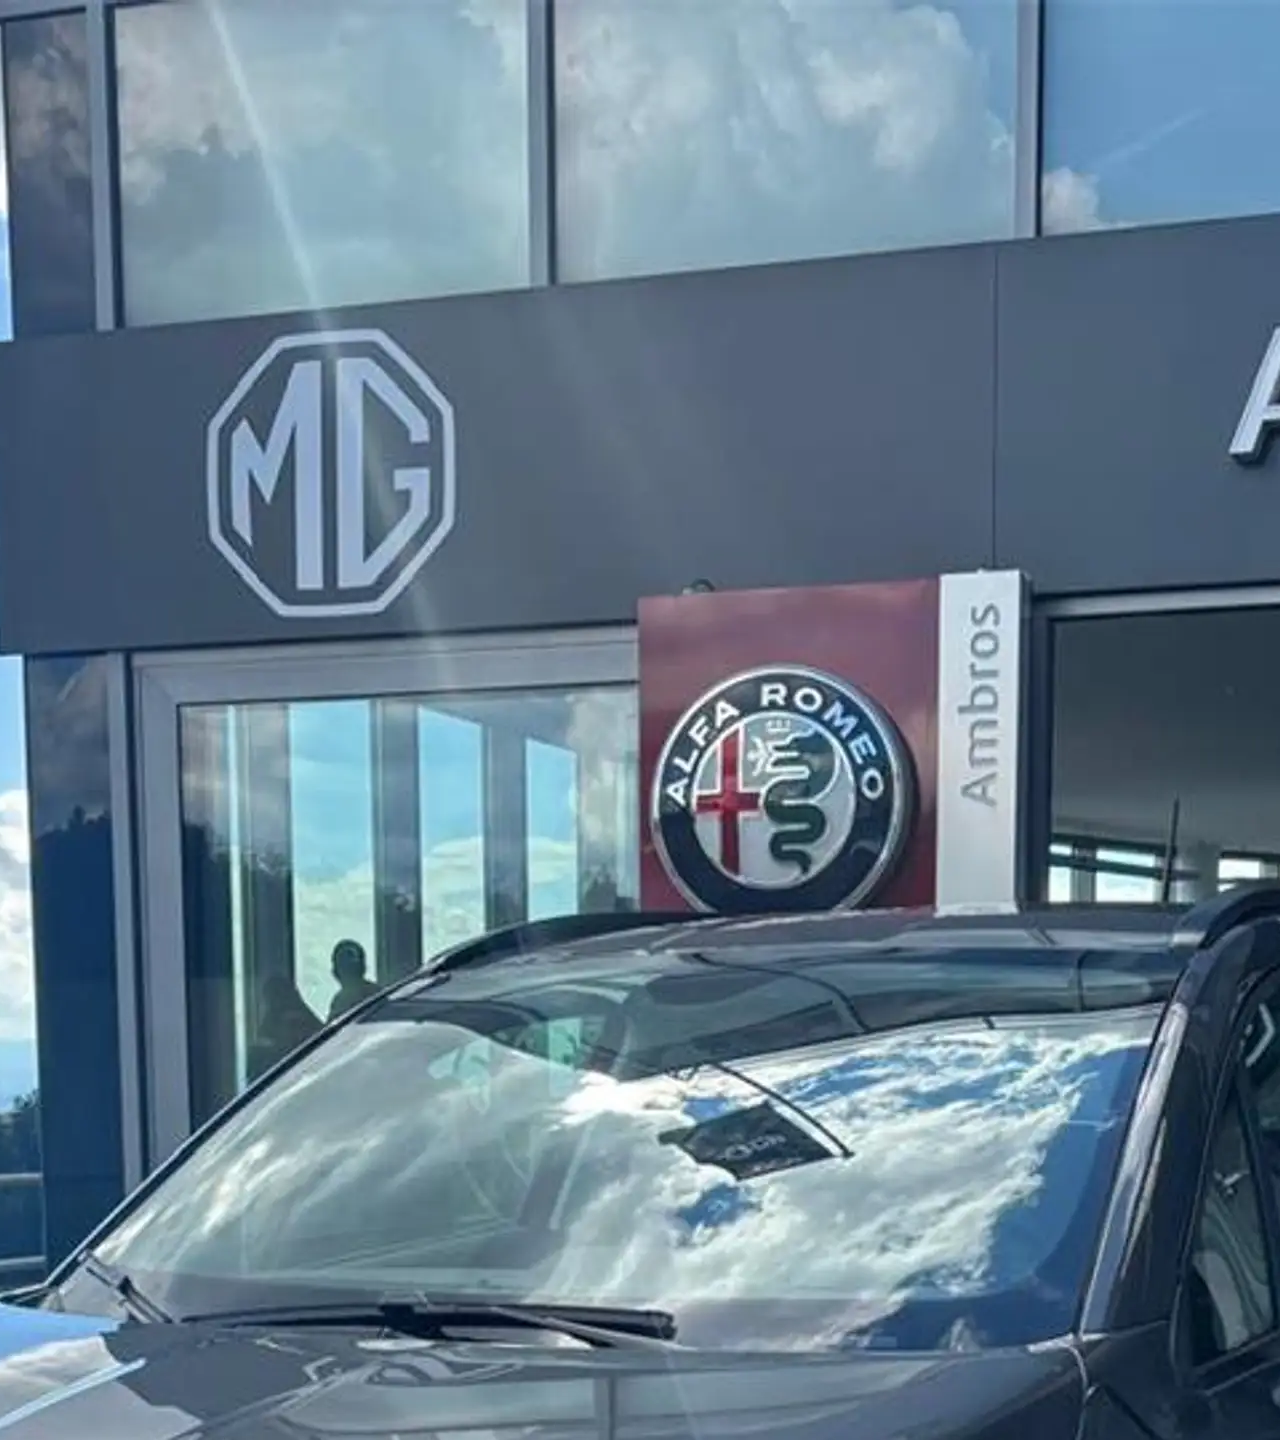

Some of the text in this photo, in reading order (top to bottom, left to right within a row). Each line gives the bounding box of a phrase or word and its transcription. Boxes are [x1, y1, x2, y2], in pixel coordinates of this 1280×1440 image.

[231, 357, 431, 590] MG
[666, 682, 885, 807] ALFA ROMEO
[958, 602, 1001, 808] Ambros
